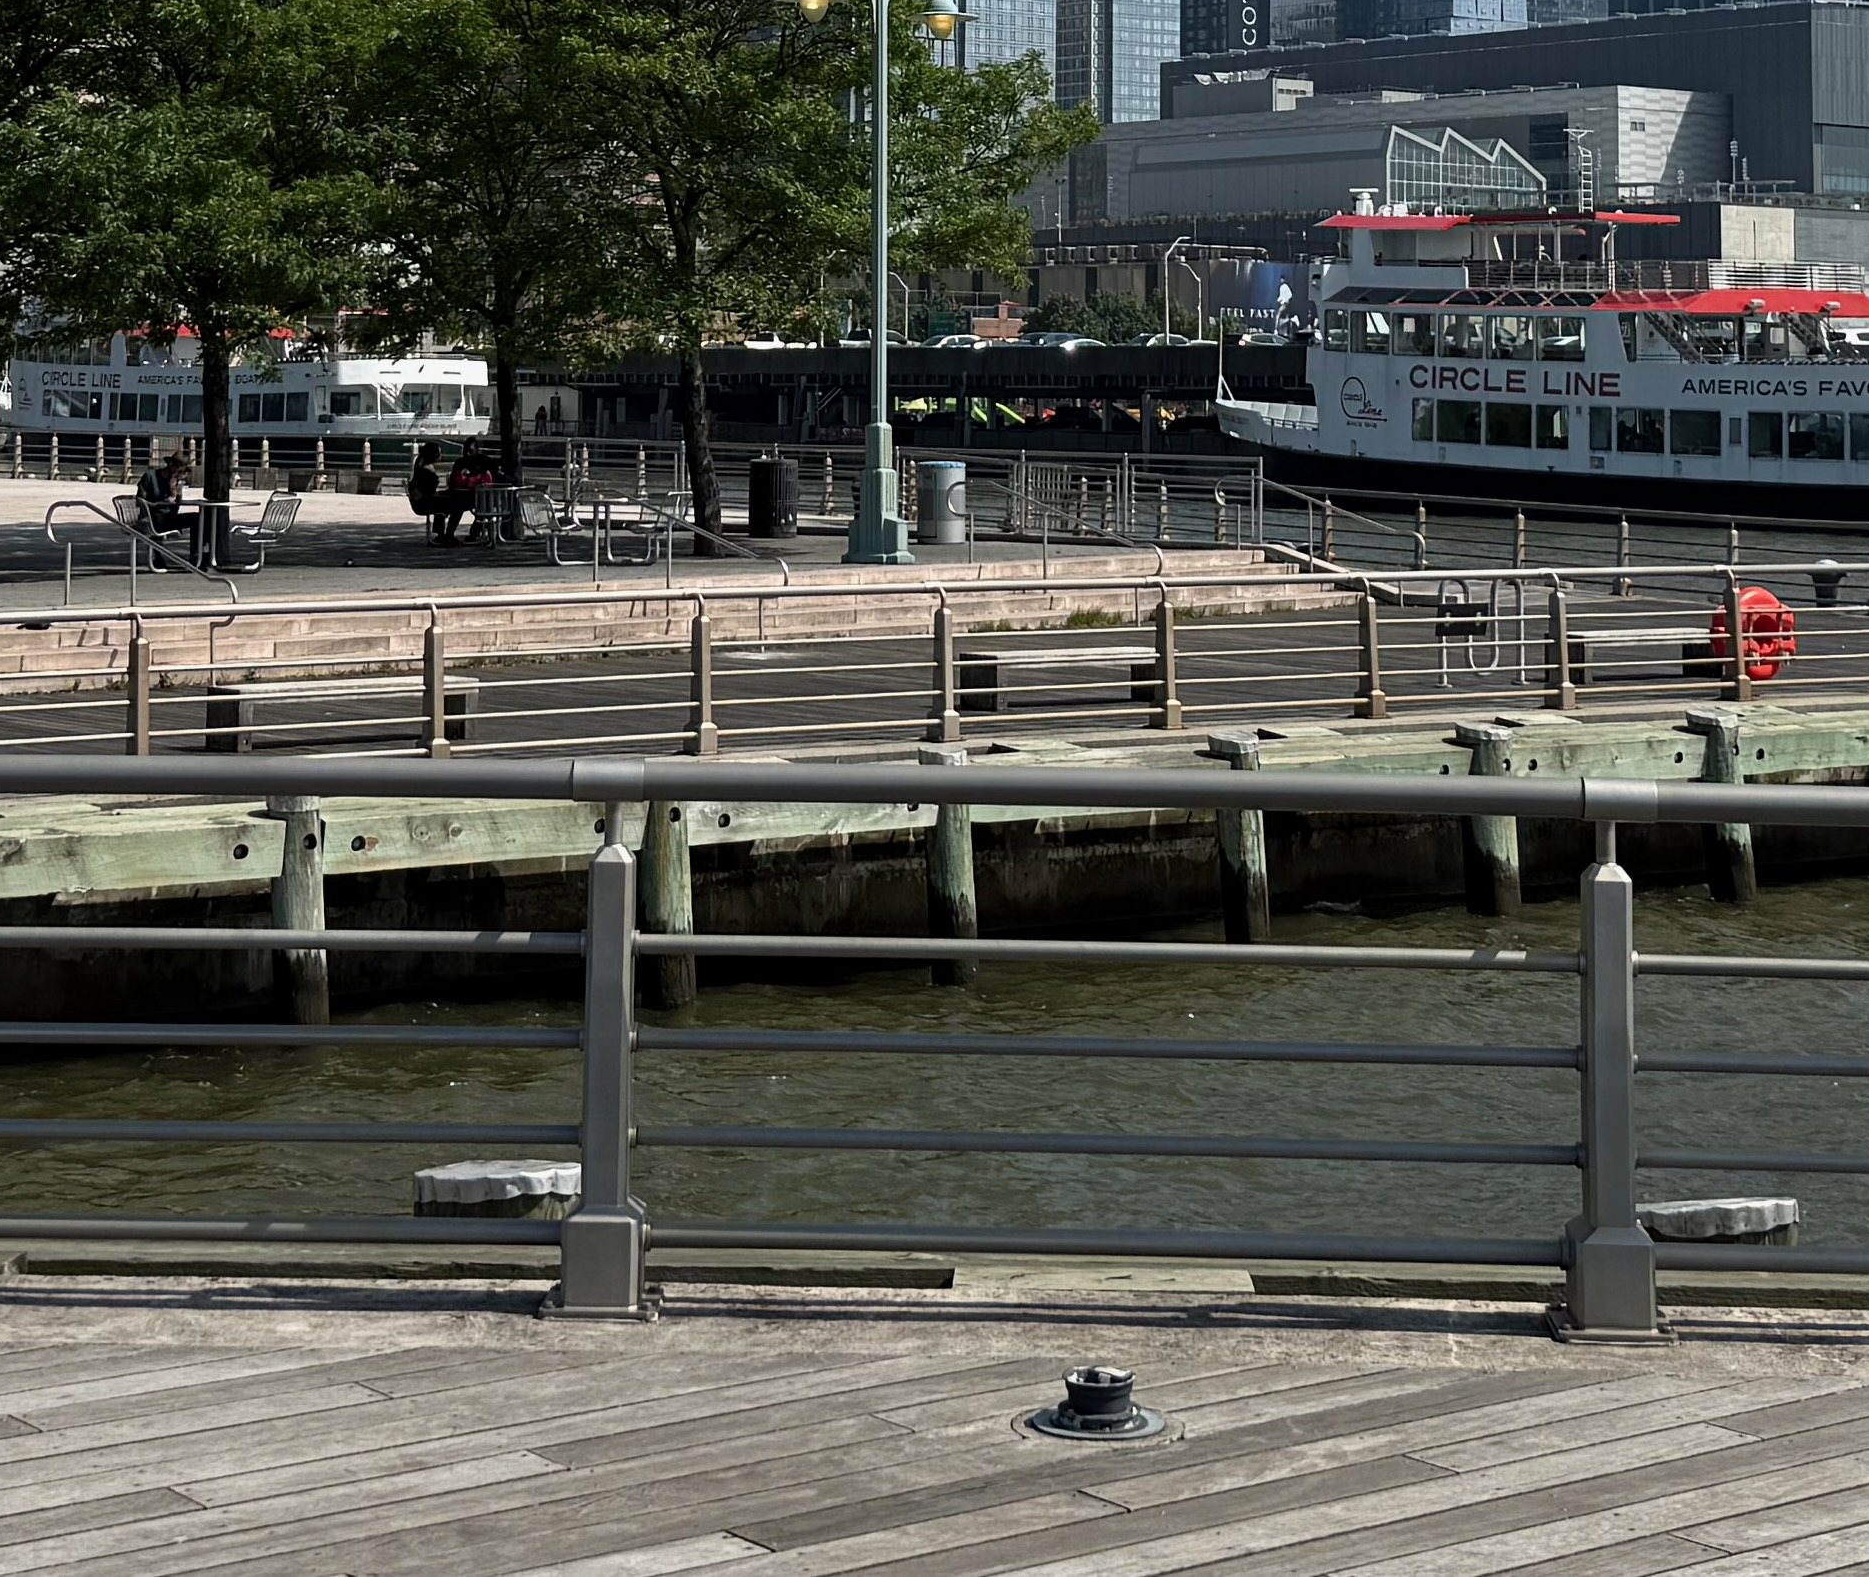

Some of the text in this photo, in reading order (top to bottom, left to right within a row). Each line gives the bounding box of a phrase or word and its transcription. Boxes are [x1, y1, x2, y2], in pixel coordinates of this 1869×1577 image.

[1250, 308, 1276, 319] FAST
[41, 371, 122, 389] CIRCLE LINE
[1409, 364, 1621, 397] CIRCLE LINE
[1681, 378, 1808, 396] AMERICA'S
